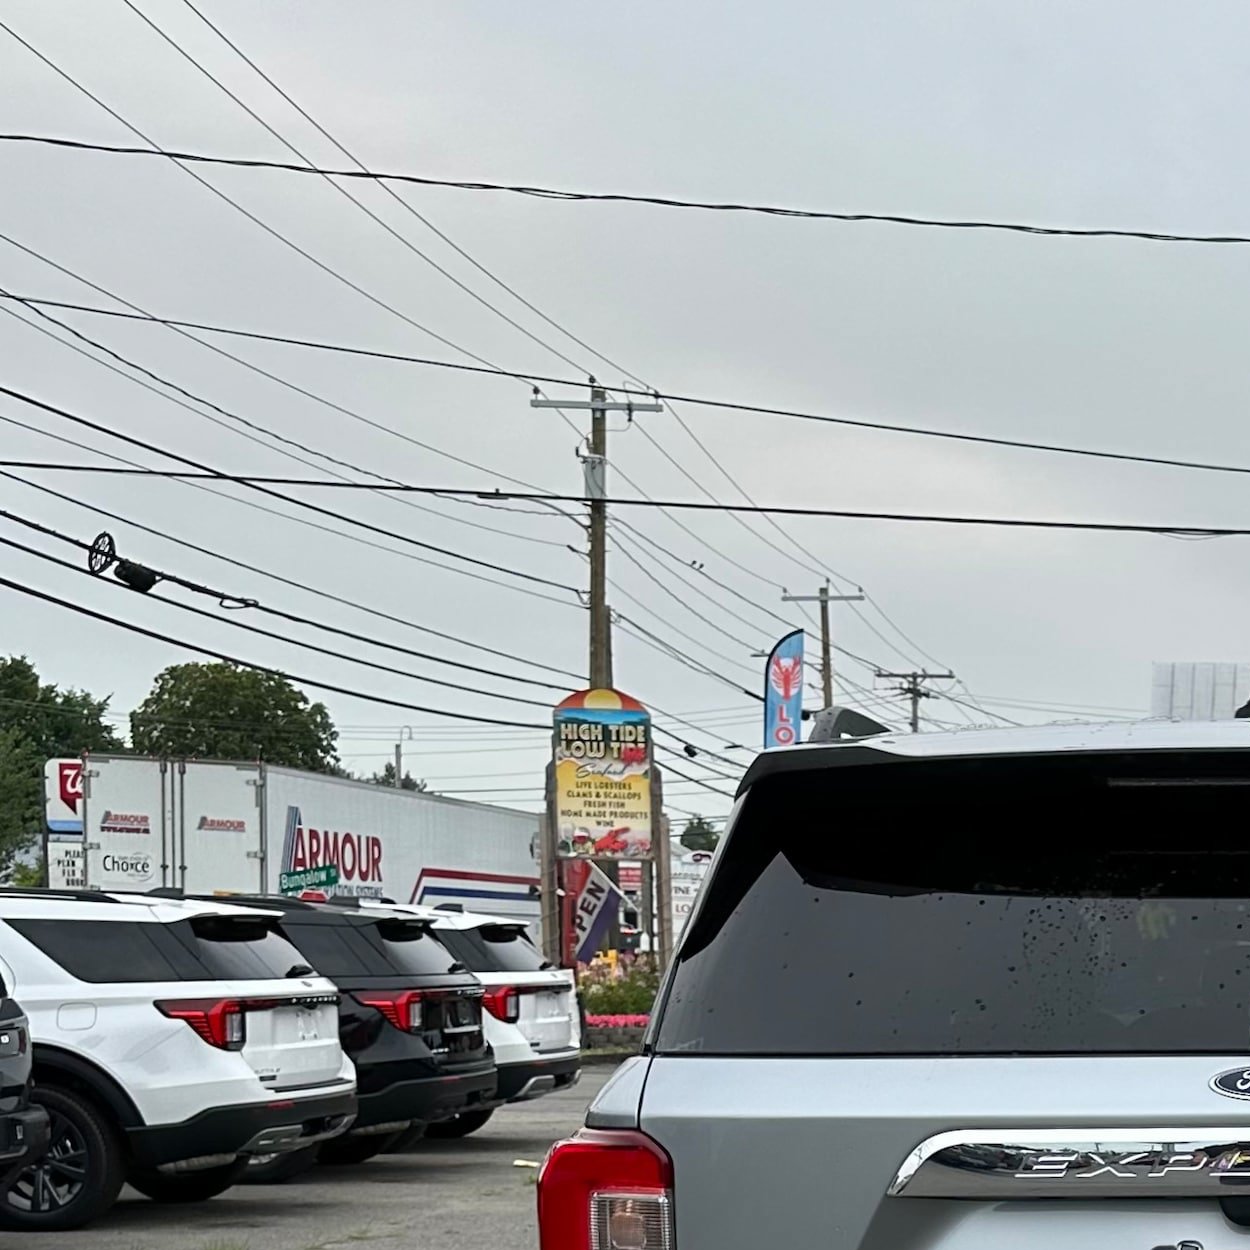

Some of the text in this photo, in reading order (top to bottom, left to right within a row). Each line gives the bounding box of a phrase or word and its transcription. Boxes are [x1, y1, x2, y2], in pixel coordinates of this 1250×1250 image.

[561, 723, 646, 742] HIGH TIDE
[561, 741, 605, 758] LOW
[594, 782, 632, 790] LOBSTERS
[566, 790, 642, 801] CLAMS & SCALLOPS
[583, 800, 626, 809] FRESH FISH
[103, 811, 149, 823] ARMOUR
[560, 809, 583, 817] HOME
[609, 811, 649, 820] PRODUCTS
[199, 817, 246, 829] ARMOUR
[596, 820, 615, 828] WINE
[288, 824, 383, 882] ARMOUR
[281, 868, 328, 890] Bungalow
[574, 880, 606, 942] PEN
